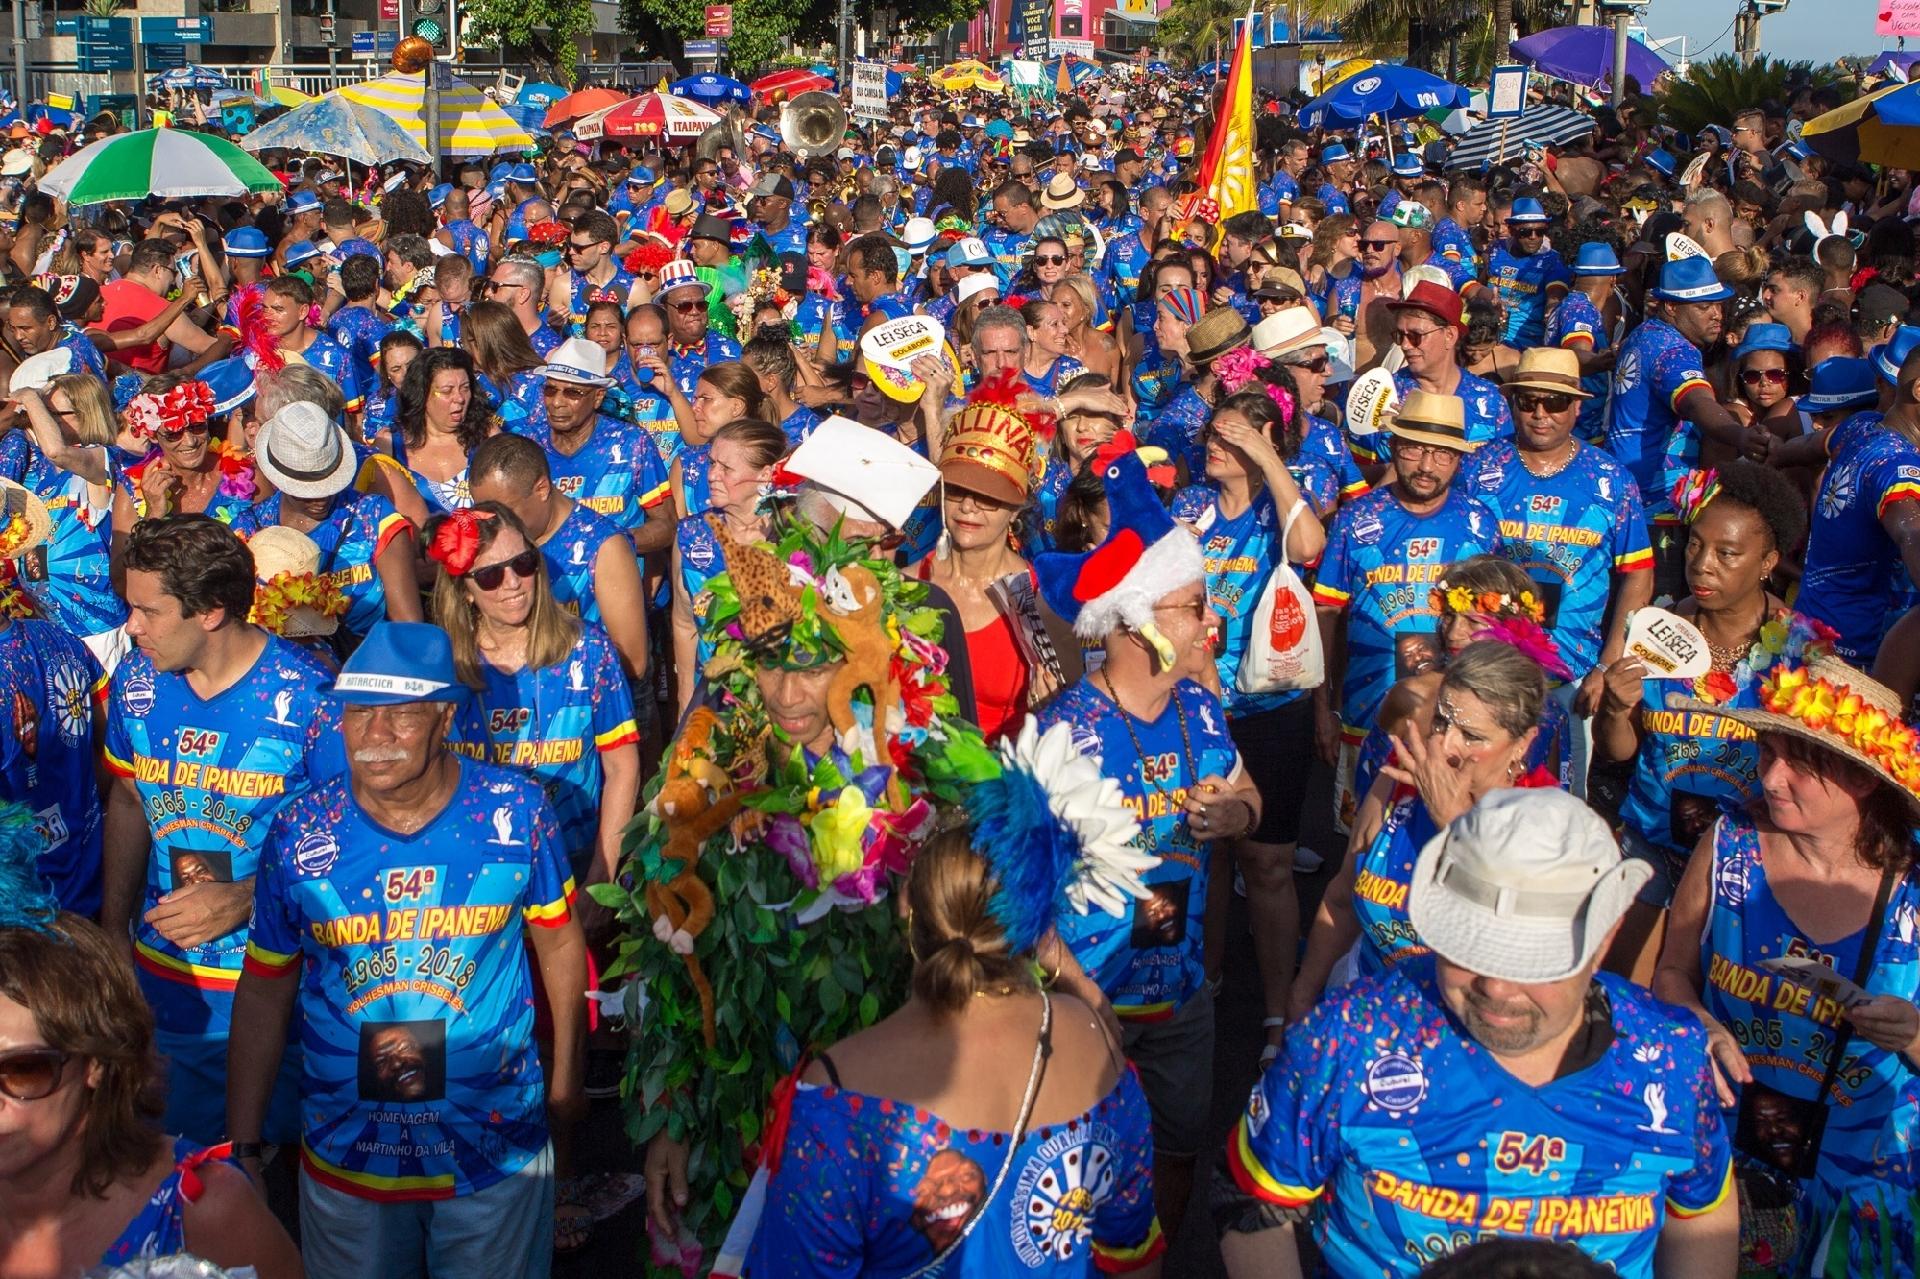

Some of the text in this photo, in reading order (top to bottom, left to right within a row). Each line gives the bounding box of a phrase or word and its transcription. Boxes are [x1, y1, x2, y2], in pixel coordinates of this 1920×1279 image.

[1027, 37, 1047, 46] QUANTO
[1028, 45, 1047, 56] DEUS
[1417, 92, 1440, 107] BOA
[578, 122, 600, 136] ITAIPAVA
[873, 321, 928, 347] LEI SECA
[892, 336, 931, 358] COLABORE
[1351, 378, 1381, 424] LEI SECA
[1372, 387, 1391, 427] COLABORE
[648, 420, 681, 432] IPANEM
[557, 475, 583, 494] 54ª
[1529, 494, 1561, 513] 54ª
[1407, 537, 1438, 559] 54ª
[1526, 523, 1544, 541] DE
[1547, 523, 1603, 547] IPANEMA
[1504, 542, 1532, 559] 965
[1546, 542, 1583, 573] 2018
[1406, 565, 1424, 584] DE
[1379, 587, 1414, 614] 1965
[1647, 618, 1698, 664] LEI SECA
[1633, 643, 1678, 673] COLABORE
[490, 707, 530, 734] 54ª
[1688, 713, 1714, 737] DE
[179, 727, 218, 757] 54ª
[491, 742, 512, 764] DE
[514, 737, 584, 768] IPANEMA
[1142, 753, 1178, 784] 54ª
[1714, 742, 1758, 783] 2018
[174, 761, 199, 788] DE
[201, 765, 286, 799] IPANEMA
[146, 787, 187, 823] 1965
[201, 795, 253, 834] 2018
[1148, 792, 1168, 817] DE
[385, 867, 437, 903] 54ª
[1354, 868, 1409, 911] BANDA
[311, 904, 513, 949] BANDA DE IPANEMA
[1370, 919, 1418, 948] 1965
[341, 945, 398, 993] 1965
[417, 944, 476, 988] 2018
[345, 980, 409, 1016] YOLHESMAN
[1709, 953, 1771, 1009] BANDA
[1773, 981, 1813, 1017] DE
[367, 1109, 440, 1125] HOMENAGEM
[355, 1138, 456, 1157] MARTINHO DA VILA
[399, 1128, 409, 1141] A
[1494, 1130, 1566, 1176] 54ª
[1481, 1198, 1532, 1235] DE
[1533, 1191, 1658, 1237] IPANEMA
